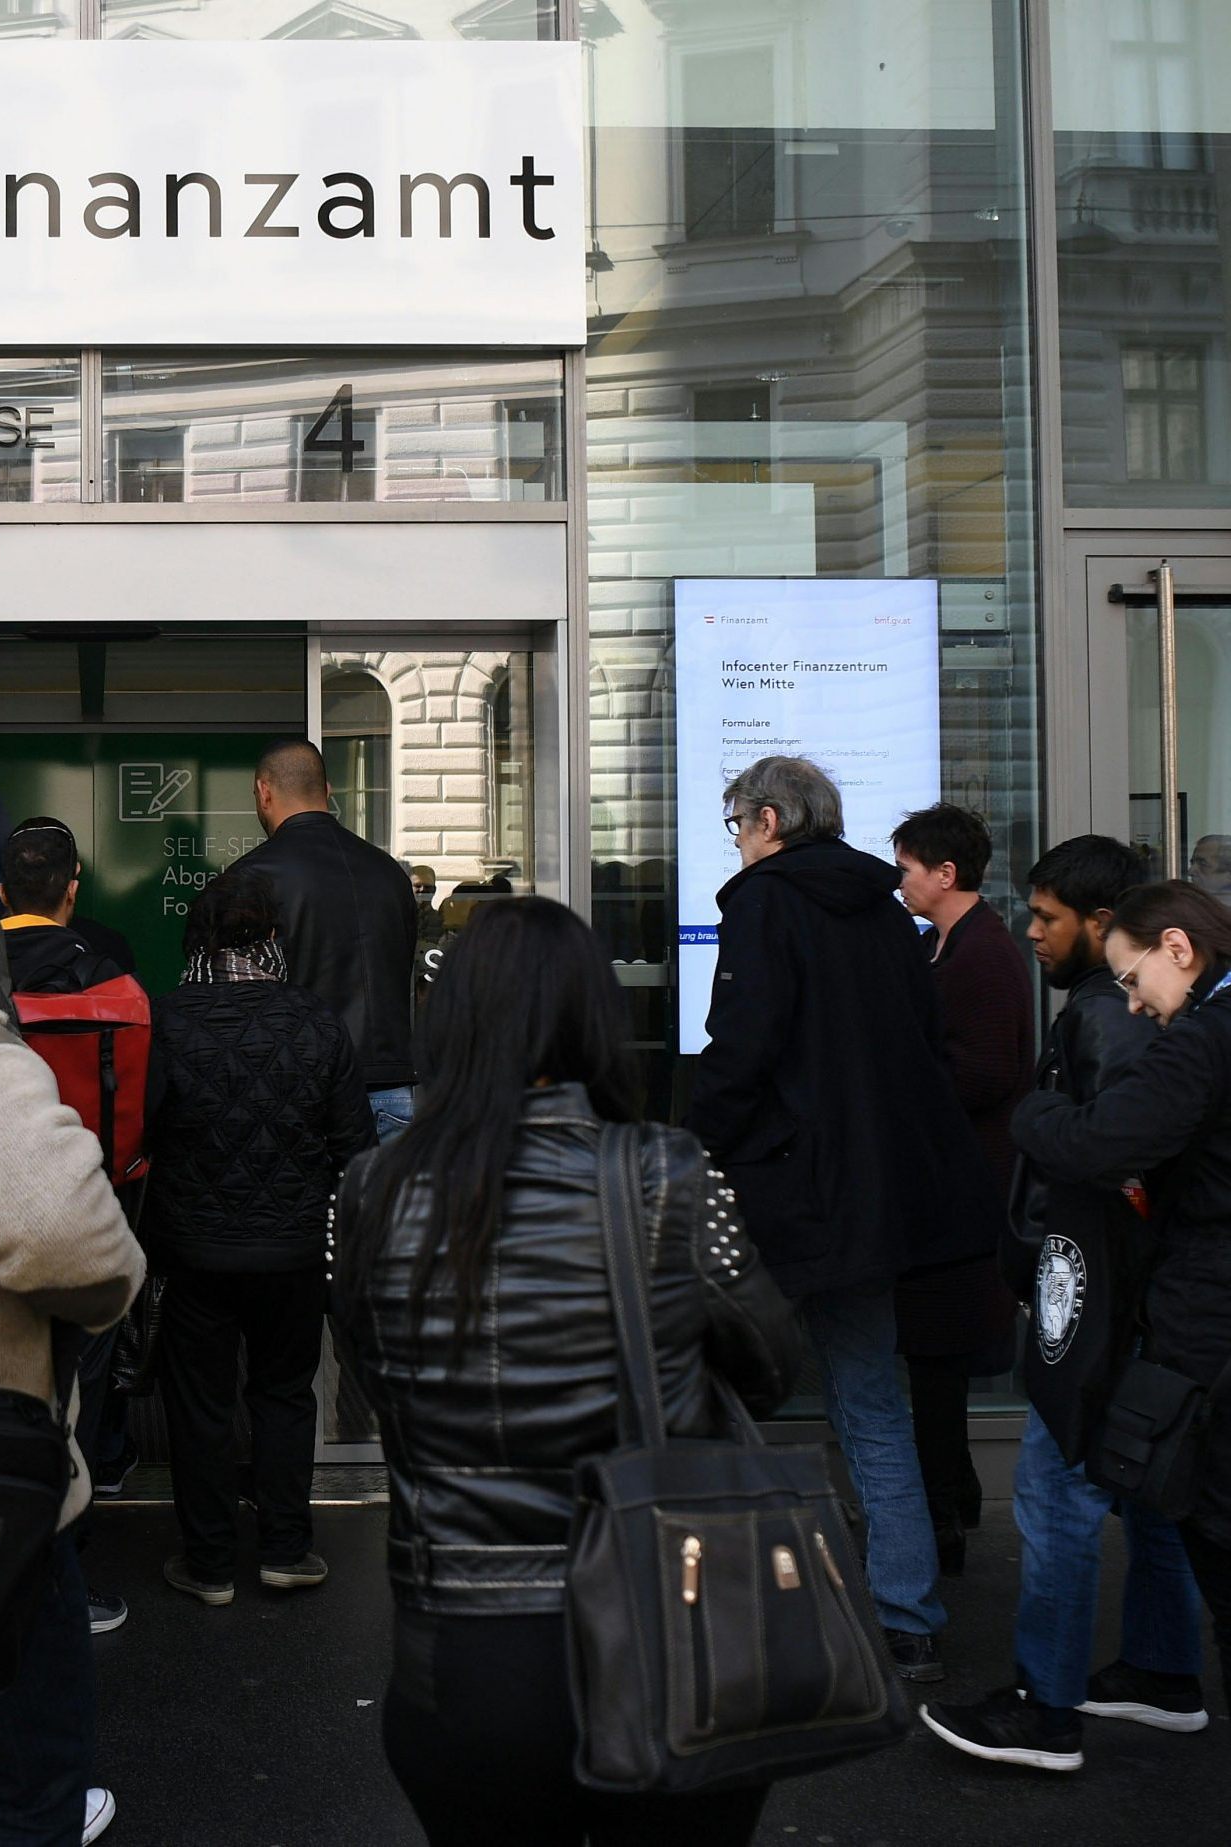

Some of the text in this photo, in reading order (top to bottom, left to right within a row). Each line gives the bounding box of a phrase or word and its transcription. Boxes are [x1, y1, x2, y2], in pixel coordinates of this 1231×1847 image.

[303, 384, 365, 472] 4
[720, 615, 769, 625] Finanzamt
[874, 616, 911, 627] bmf.gv.at
[721, 660, 888, 672] Infocenter Finanzzentrum
[721, 678, 795, 690] Wien Mitte
[722, 718, 771, 728] Formulare
[162, 864, 225, 891] Abga
